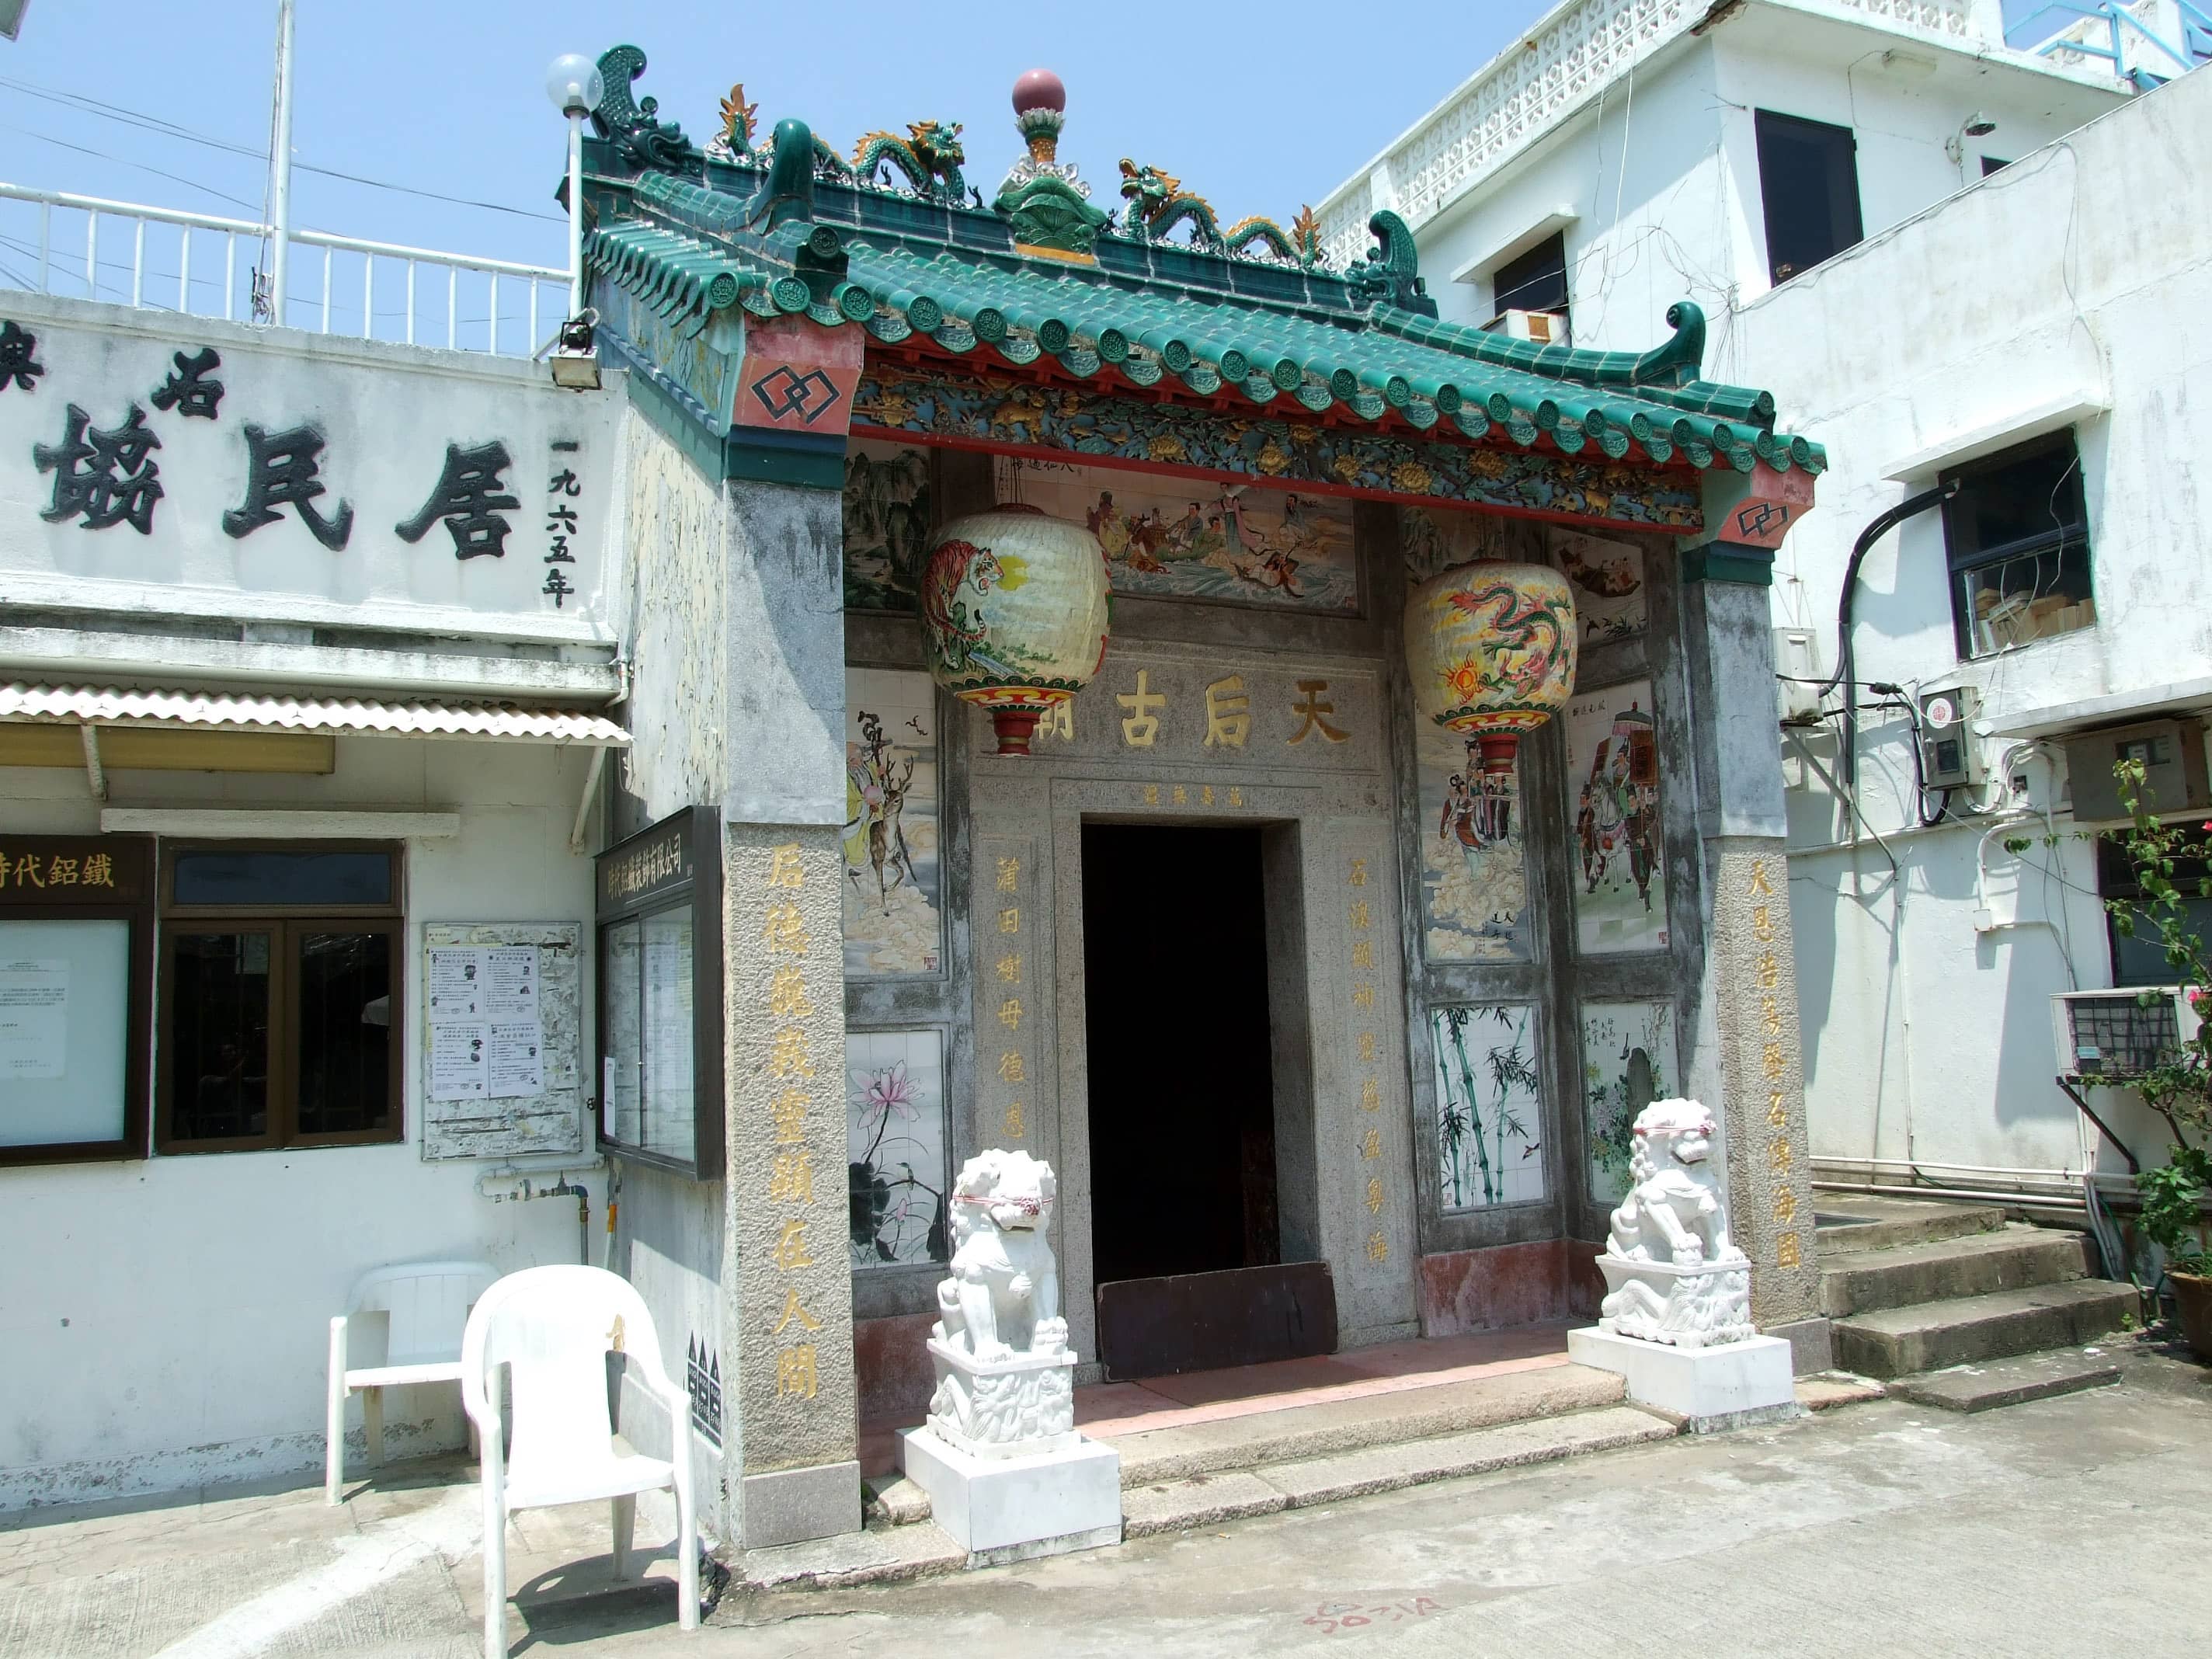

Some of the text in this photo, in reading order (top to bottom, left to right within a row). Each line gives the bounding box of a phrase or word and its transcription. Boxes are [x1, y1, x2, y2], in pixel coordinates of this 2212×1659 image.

[542, 441, 581, 609] 一九六五年
